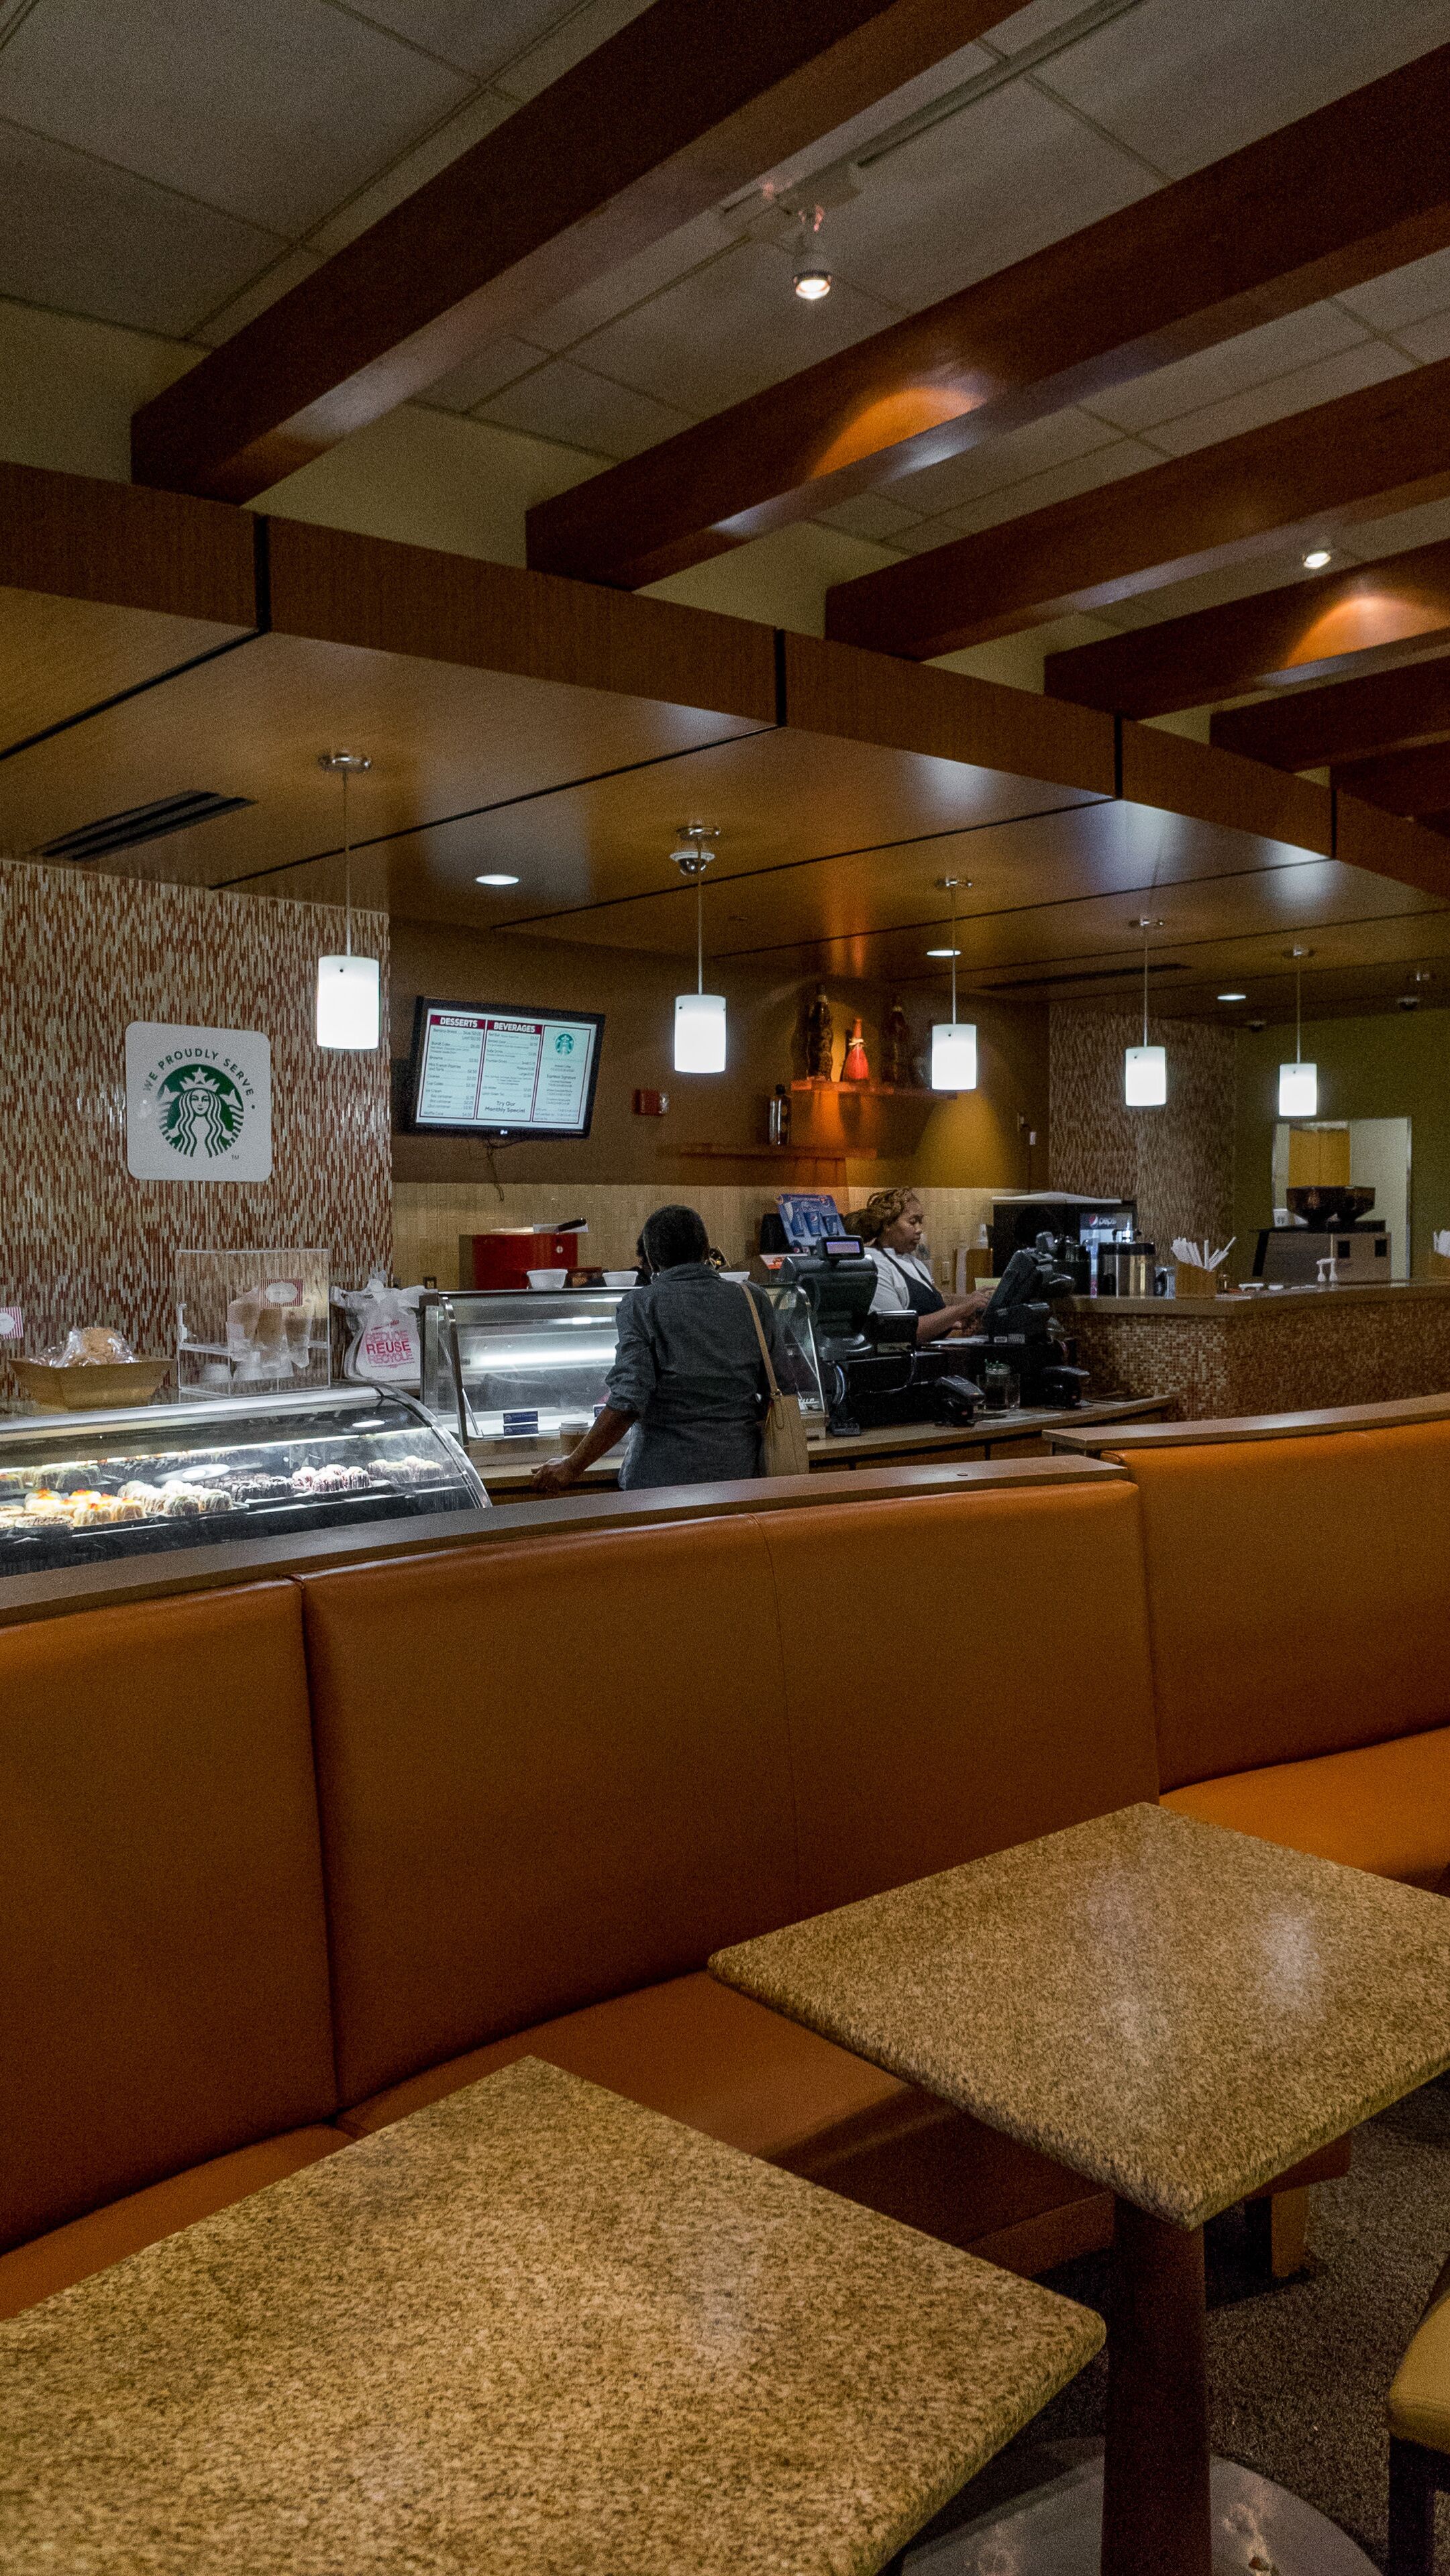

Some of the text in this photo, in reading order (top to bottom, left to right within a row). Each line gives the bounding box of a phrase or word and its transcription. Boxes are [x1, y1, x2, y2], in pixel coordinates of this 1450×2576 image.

[439, 1017, 478, 1028] DESSERTS
[493, 1022, 535, 1032] BEVERAGES
[142, 1048, 254, 1097] WE PROUDLY SERVE
[366, 1340, 411, 1355] REUSE
